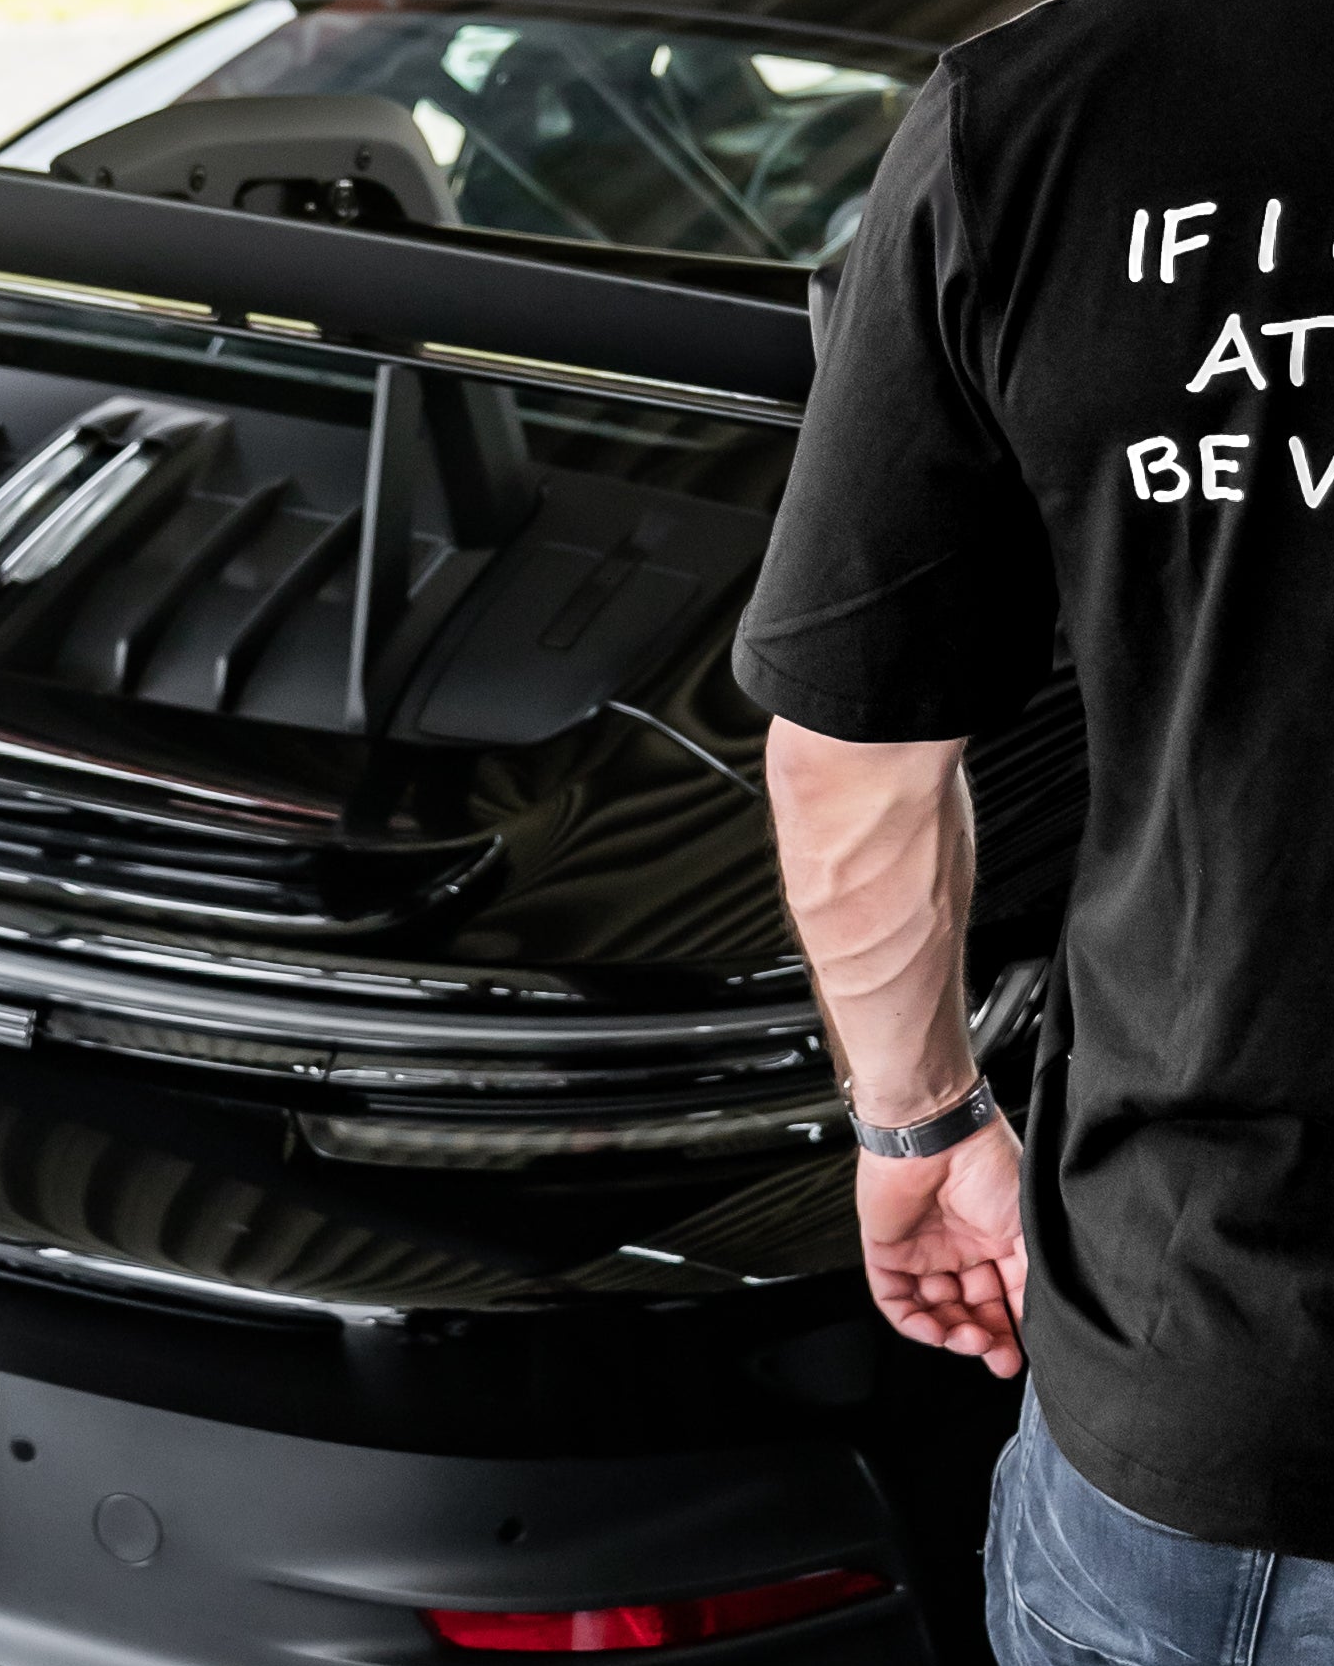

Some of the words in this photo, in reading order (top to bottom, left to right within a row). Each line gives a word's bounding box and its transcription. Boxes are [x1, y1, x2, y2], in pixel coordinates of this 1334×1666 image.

[1127, 201, 1218, 284] IF
[1257, 198, 1282, 273] I
[1126, 433, 1251, 503] BE
